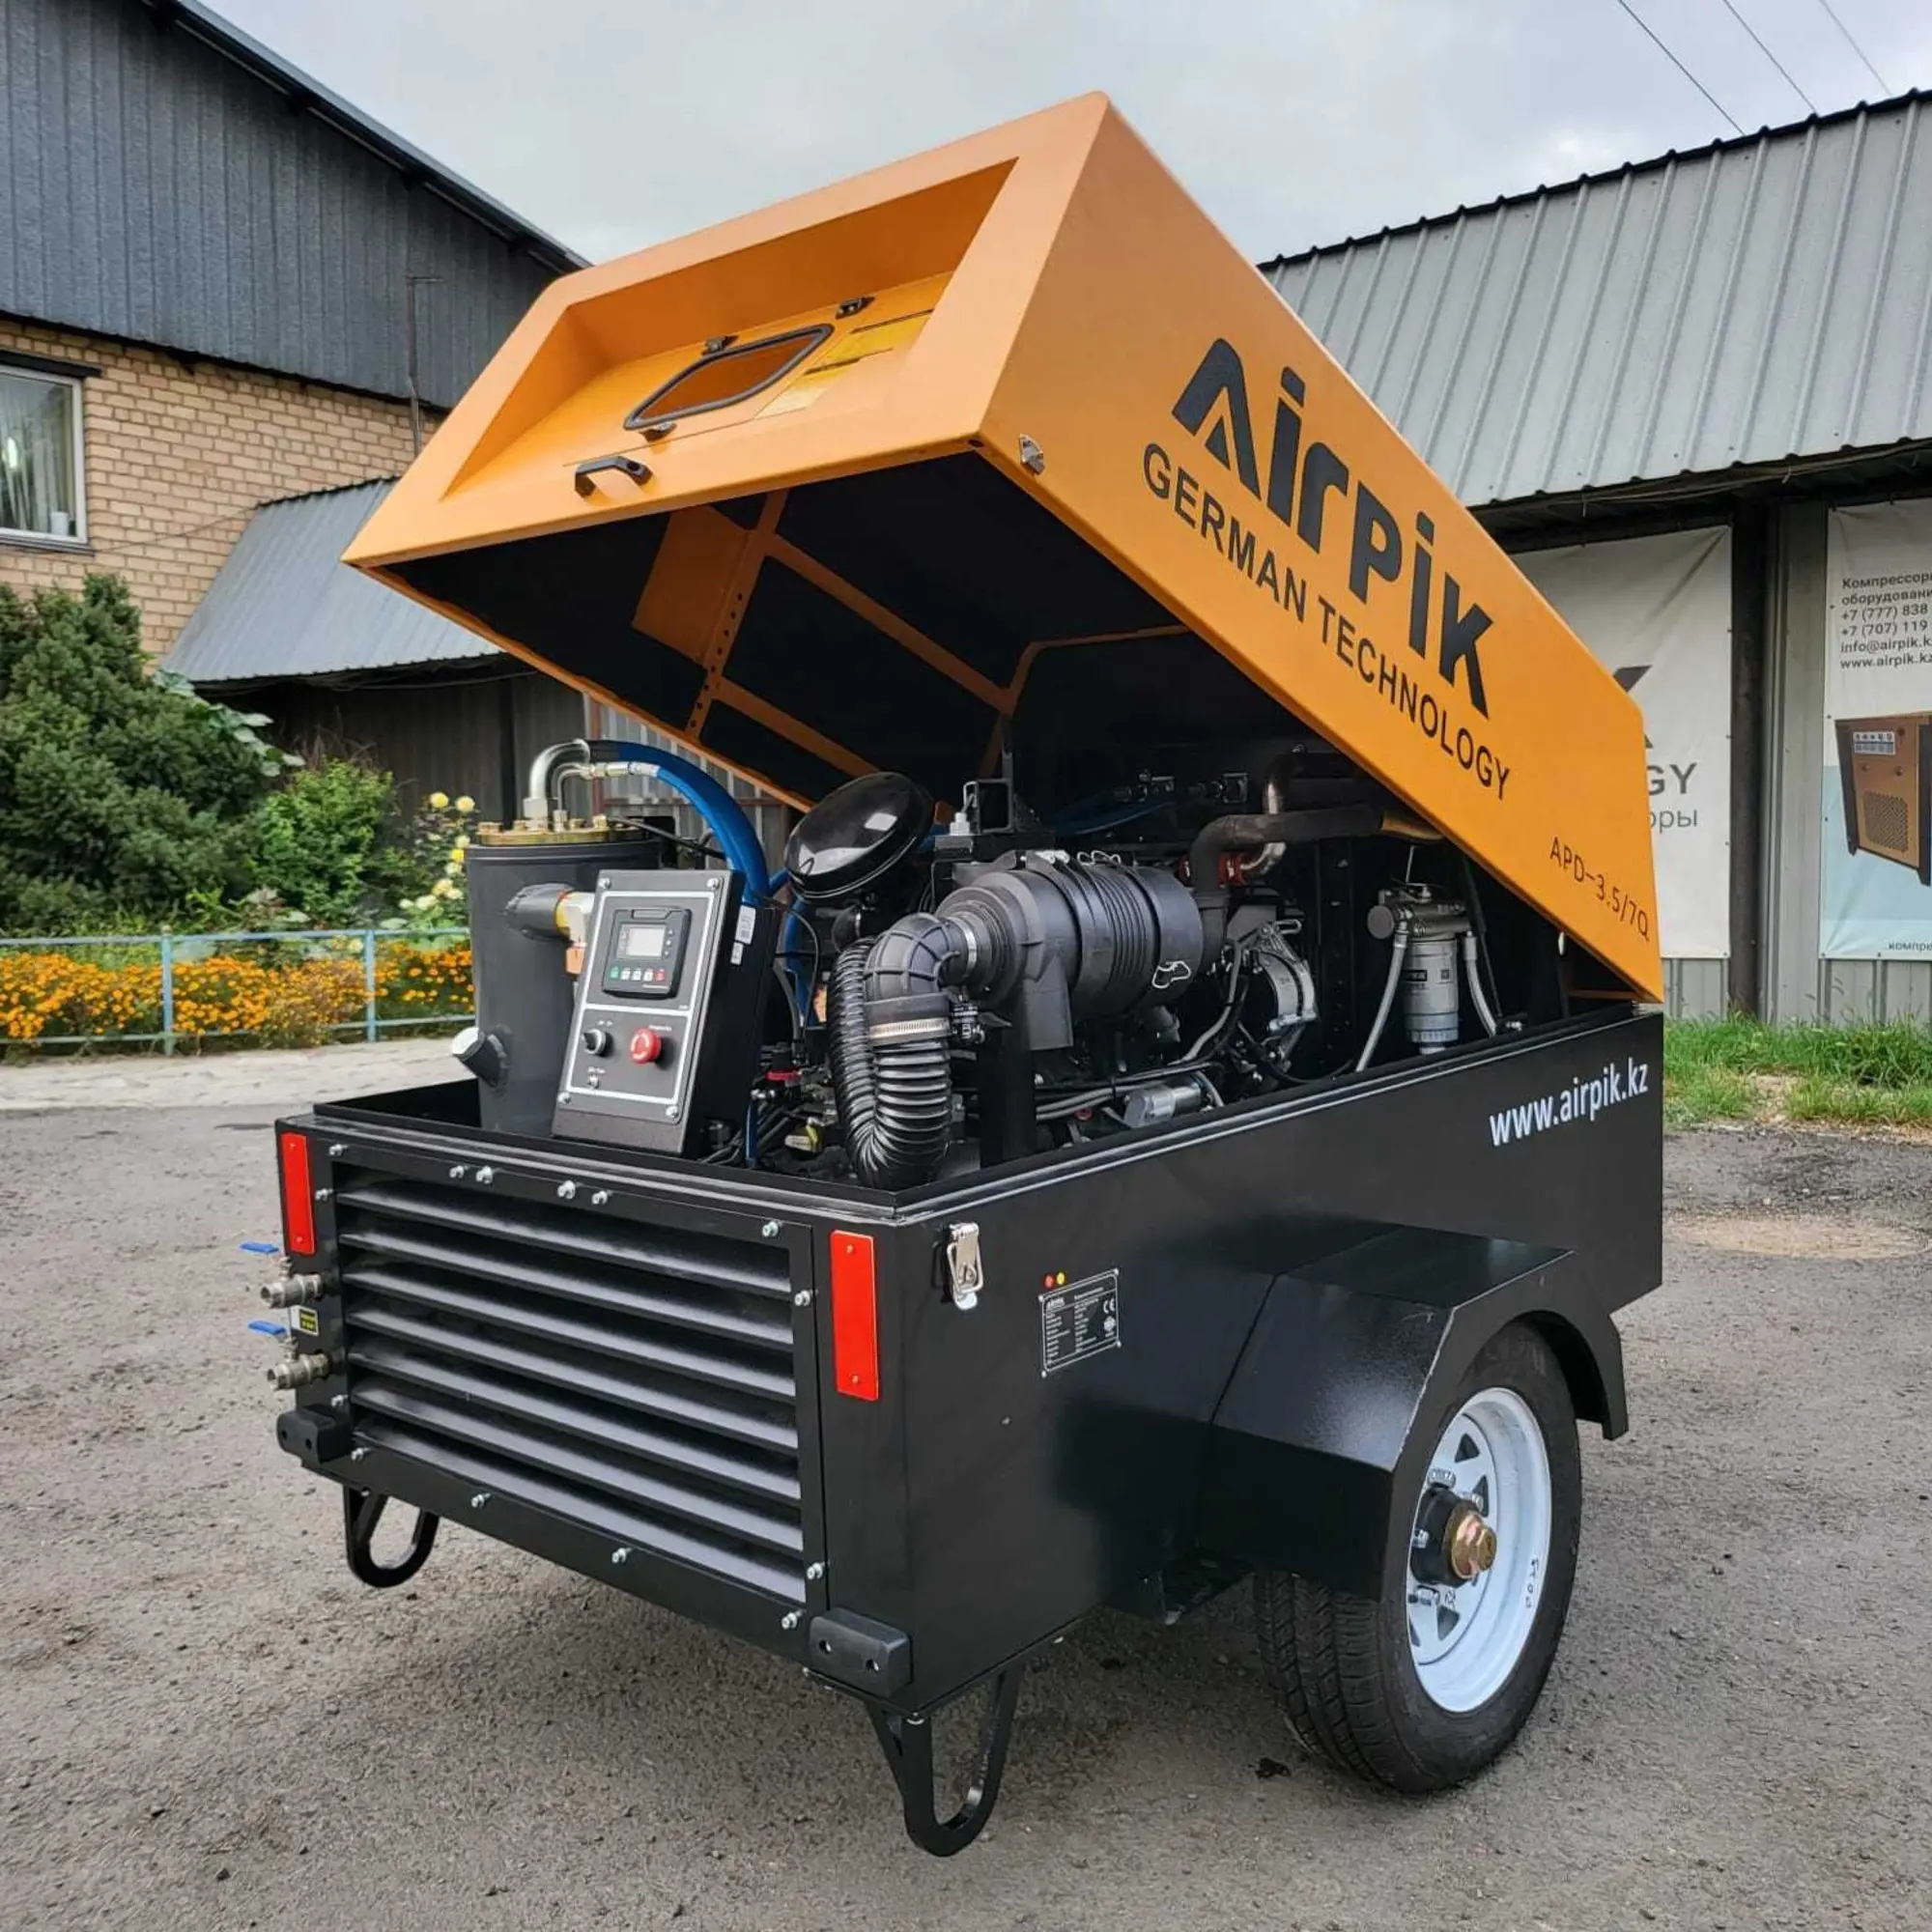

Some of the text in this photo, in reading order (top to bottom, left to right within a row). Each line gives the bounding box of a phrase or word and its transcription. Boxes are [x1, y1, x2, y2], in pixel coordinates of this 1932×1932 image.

[1841, 573, 1932, 589] Компрессор
[1142, 442, 1308, 623] GERMAN
[1317, 595, 1511, 802] TECHNOLOGY
[1841, 603, 1928, 623] +7 (777) 838
[1841, 619, 1928, 639] +7 (707) 119
[1549, 837, 1650, 942] APD-3.5/7Q
[1489, 1056, 1649, 1147] www.airpik.kz
